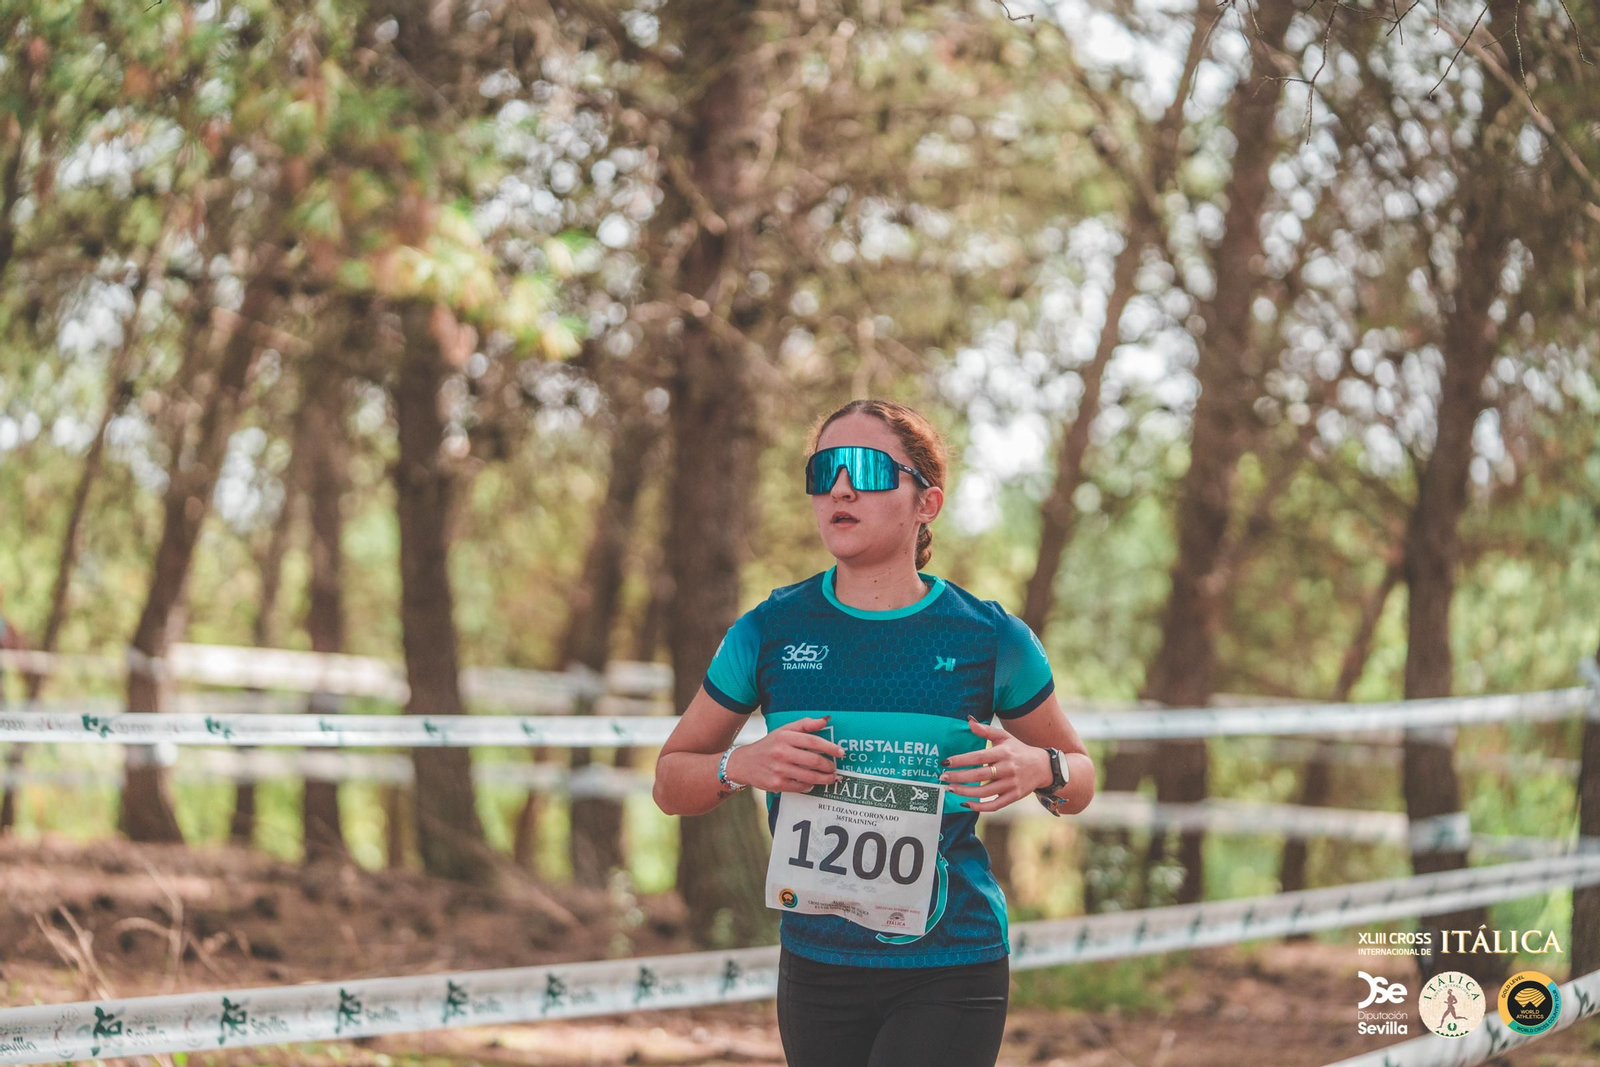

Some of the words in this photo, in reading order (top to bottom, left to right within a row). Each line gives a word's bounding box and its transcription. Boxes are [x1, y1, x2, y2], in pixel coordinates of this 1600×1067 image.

[782, 642, 819, 662] 365
[782, 662, 823, 671] TRAINING
[838, 739, 940, 757] CRISTALERIA
[842, 764, 862, 774] ISLA
[880, 754, 891, 764] J.
[899, 755, 939, 768] REYES
[818, 803, 831, 811] RUT
[832, 806, 858, 816] LOZANO
[859, 811, 900, 822] CORONADO
[836, 814, 877, 827] 365TRAINING
[788, 819, 925, 885] 1200
